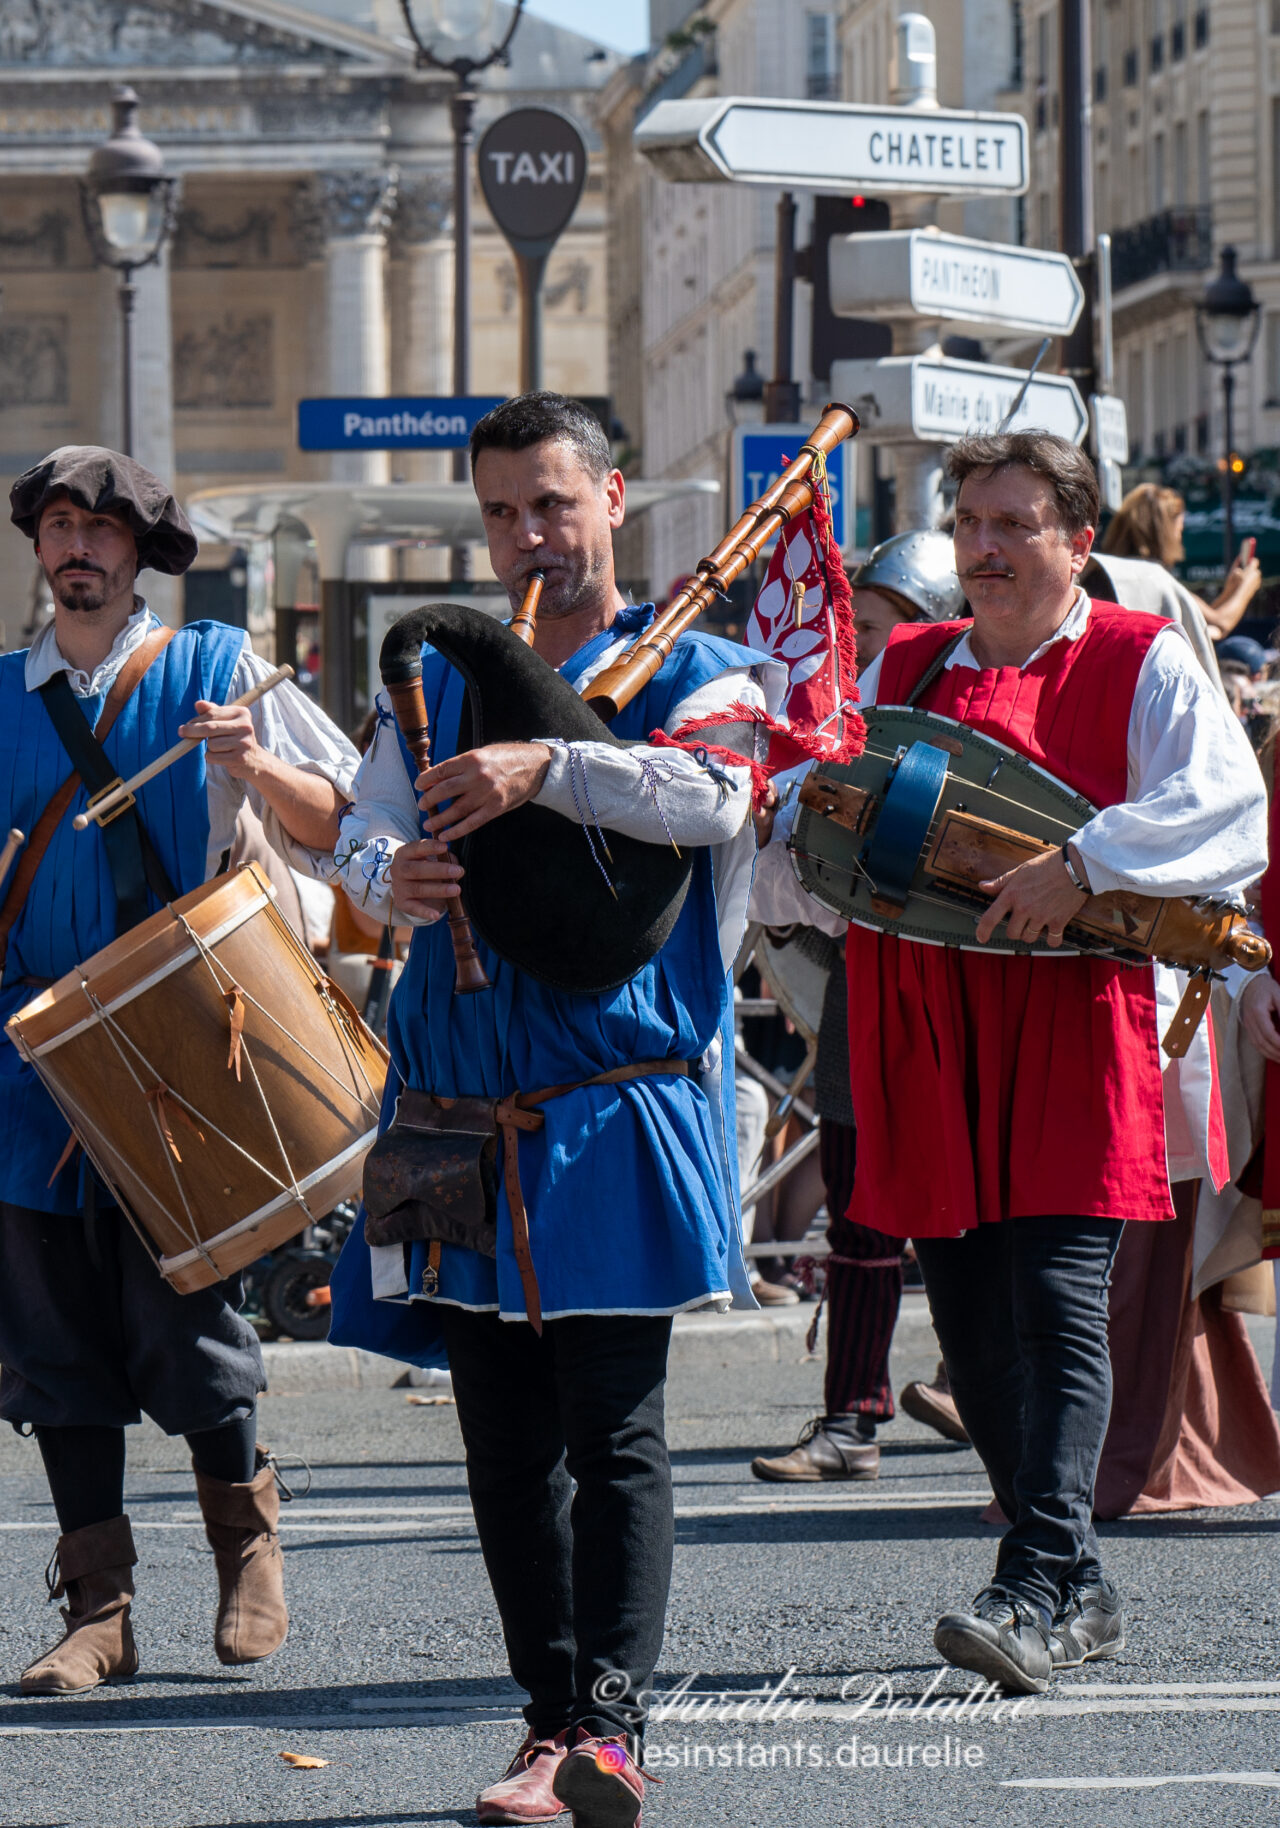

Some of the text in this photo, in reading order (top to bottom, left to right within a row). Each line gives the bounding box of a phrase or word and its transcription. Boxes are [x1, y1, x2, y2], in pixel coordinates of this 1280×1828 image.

[488, 151, 575, 184] TAXI
[869, 132, 1006, 171] CHATELET
[921, 257, 1000, 301] PANTHEON
[924, 382, 968, 420] Mairie
[975, 391, 991, 422] du
[343, 410, 468, 437] Panthéon
